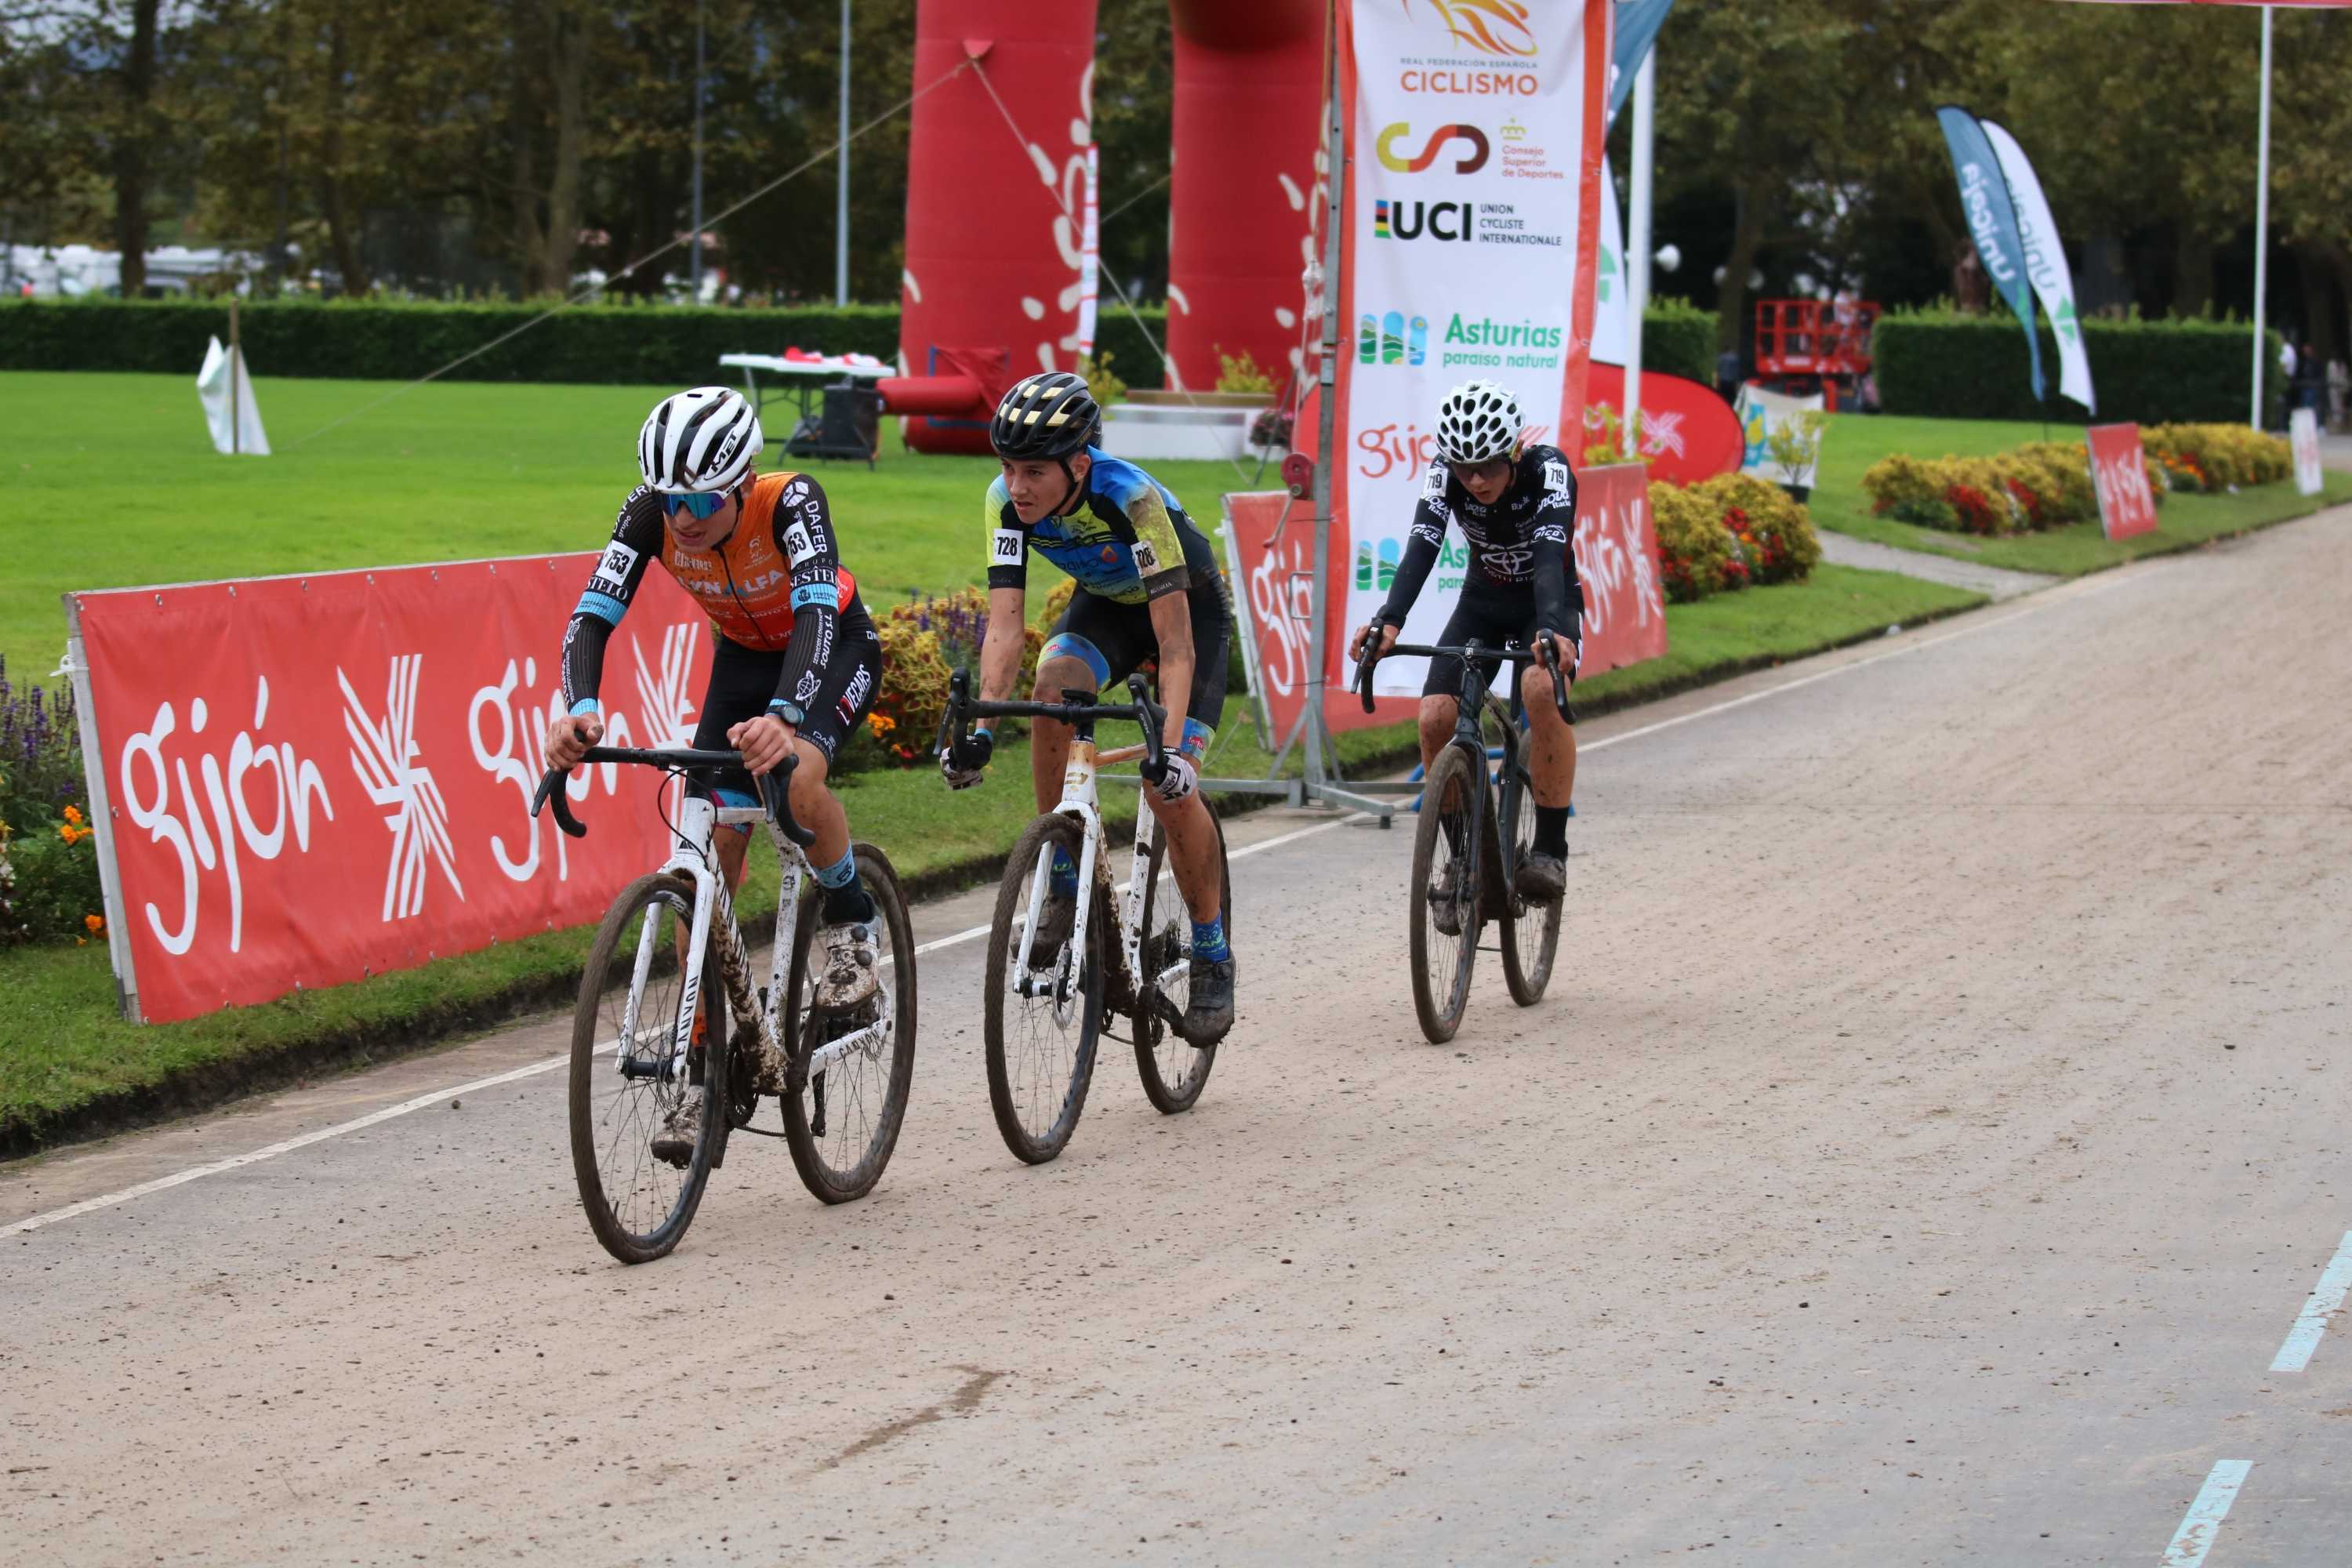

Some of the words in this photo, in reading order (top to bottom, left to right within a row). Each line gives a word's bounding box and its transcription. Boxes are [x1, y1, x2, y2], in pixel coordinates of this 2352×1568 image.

[1428, 58, 1486, 67] FEDERACIÓN
[1490, 60, 1537, 69] ESPAÑOLA
[1400, 71, 1538, 96] CICLISMO
[1501, 145, 1544, 157] Consejo
[1502, 157, 1547, 169] Superior
[1502, 168, 1515, 177] de
[1517, 169, 1564, 180] Deportes
[1480, 204, 1514, 215] UNION
[1392, 201, 1472, 242] UCI
[1479, 219, 1524, 230] CYCLISTE
[1479, 234, 1562, 246] INTERNATIONALE
[1444, 313, 1562, 348] Asturias
[1506, 353, 1558, 369] natural
[711, 430, 737, 473] MET
[1427, 474, 1443, 490] 719
[1549, 467, 1564, 485] 719
[618, 515, 632, 539] grupo
[805, 499, 828, 553] DAFER
[1413, 528, 1439, 539] PICO
[1534, 530, 1560, 539] PICO
[997, 536, 1018, 557] 728
[604, 550, 630, 575] 753
[797, 558, 833, 571] GRUPO
[821, 630, 833, 670] SOUTO
[121, 675, 334, 956] gijón
